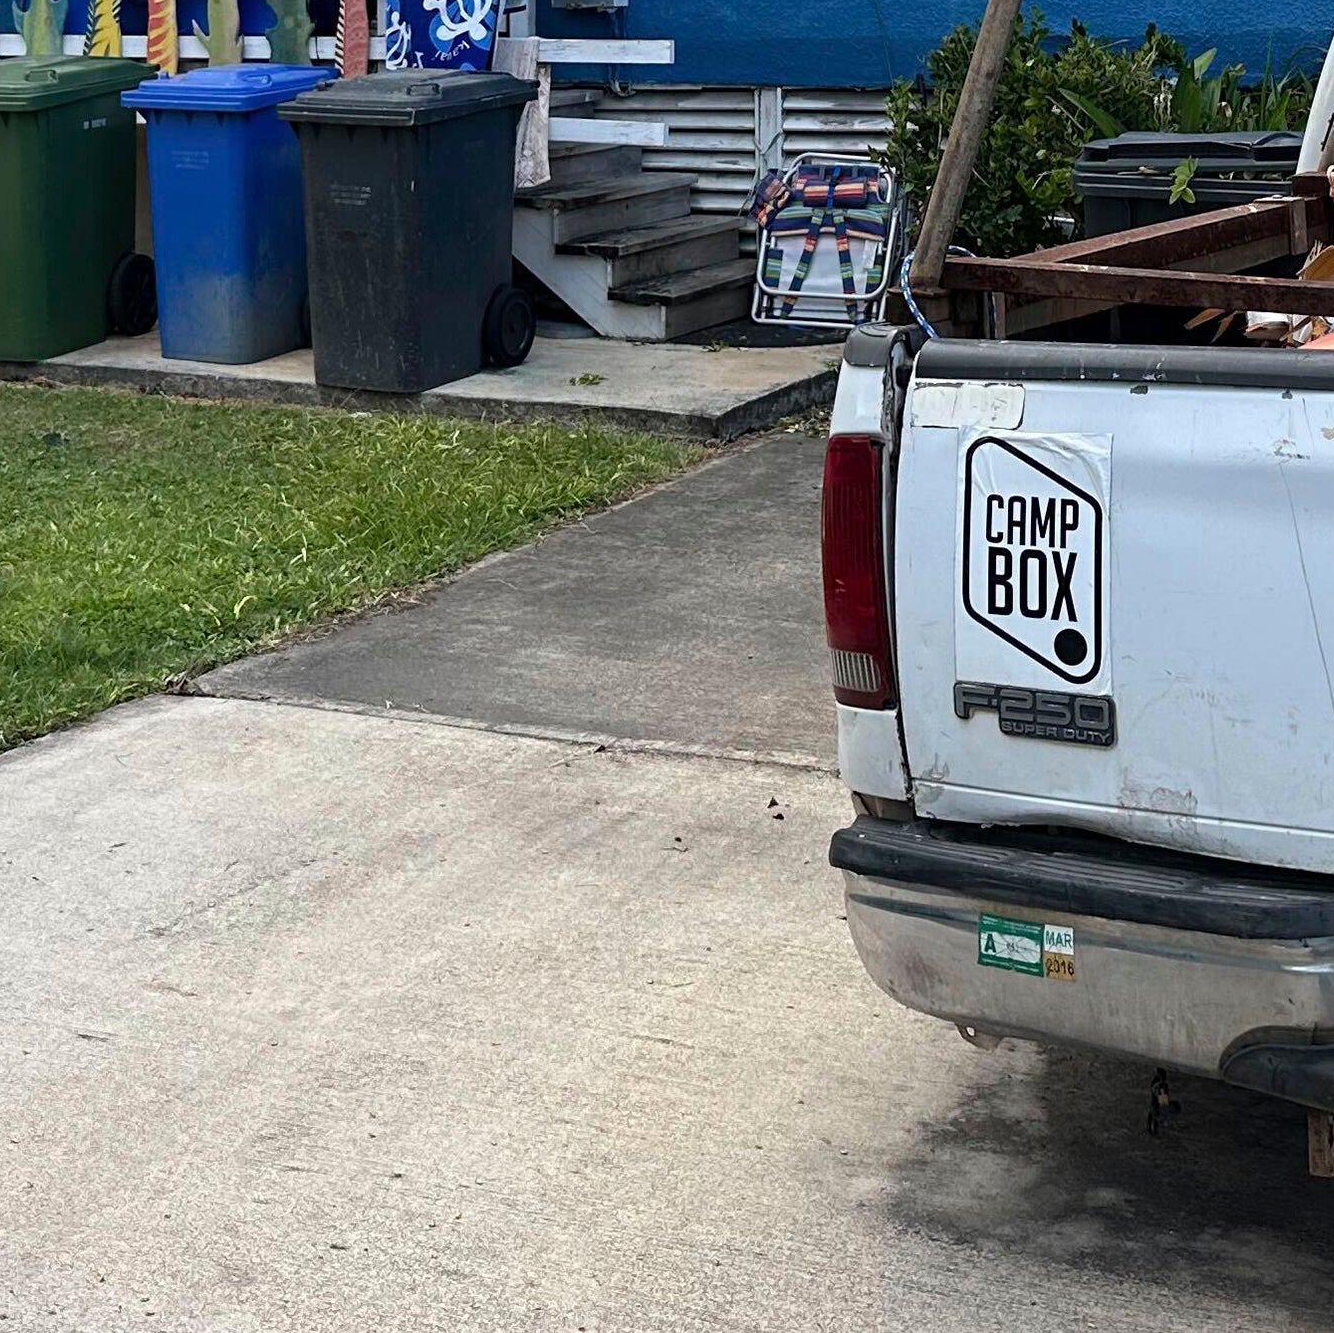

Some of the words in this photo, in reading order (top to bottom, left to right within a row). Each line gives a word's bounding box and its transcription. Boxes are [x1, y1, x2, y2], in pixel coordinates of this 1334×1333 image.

[985, 494, 1080, 549] CAMP
[987, 546, 1078, 622] BOX
[1001, 720, 1057, 737] SUPER
[1063, 728, 1110, 743] DUTY
[984, 933, 997, 953] A
[1045, 930, 1073, 949] MAR
